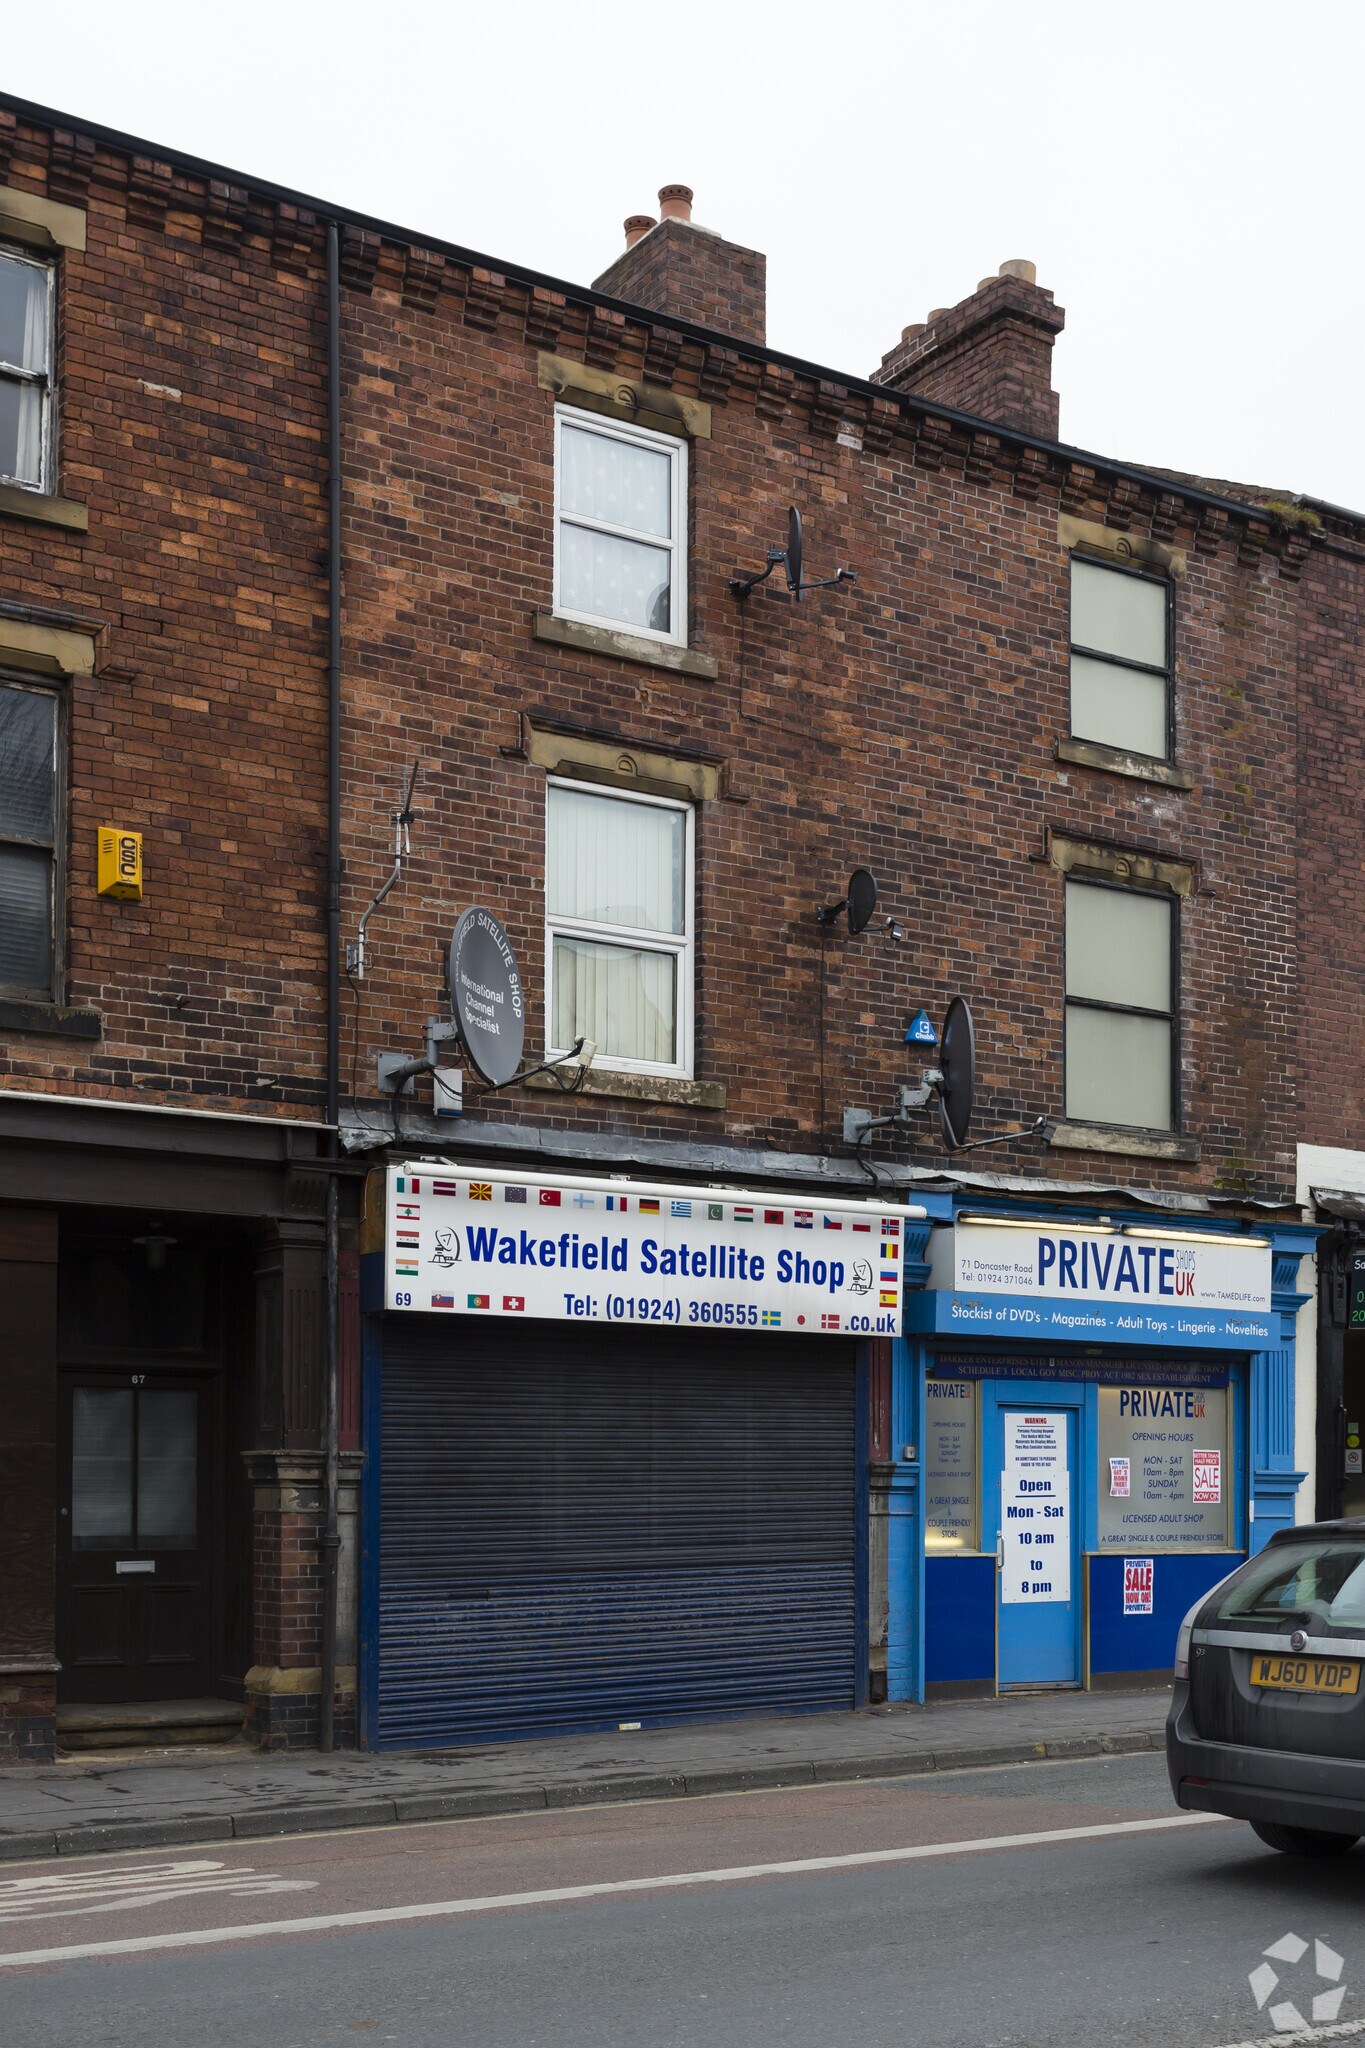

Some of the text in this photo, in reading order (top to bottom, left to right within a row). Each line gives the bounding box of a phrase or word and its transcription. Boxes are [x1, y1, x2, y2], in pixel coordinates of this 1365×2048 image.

[477, 912, 514, 968] SATELLITE
[509, 973, 522, 1018] SHOP
[461, 969, 504, 1004] International
[465, 992, 495, 1017] Channel
[464, 1007, 500, 1035] Specialist
[915, 1032, 935, 1040] Chubb
[466, 1225, 845, 1293] Wakefield Satellite Shop
[961, 1259, 1033, 1273] 71 Doncaster Road
[1038, 1236, 1174, 1295] PRIVATE
[1175, 1249, 1196, 1271] SHOPS
[962, 1272, 1033, 1286] Tel: 01924 371046
[1175, 1271, 1195, 1296] UK
[395, 1292, 412, 1307] 69
[564, 1293, 758, 1326] Tel: (01924) 360555
[844, 1313, 896, 1333] .co.uk
[951, 1304, 1269, 1337] Stockist of DVD's Magazines Adult Toys Lingerie Novelties
[131, 1374, 145, 1384] 67
[958, 1366, 1001, 1375] SCHEDULE
[1011, 1368, 1038, 1376] LOCAL
[1039, 1368, 1056, 1376] GOV
[1104, 1371, 1118, 1379] ACT
[1121, 1371, 1136, 1380] 1982
[1137, 1372, 1151, 1380] SEX
[1153, 1373, 1211, 1382] ESTABLISHMENT
[927, 1383, 965, 1398] PRIVATE
[1119, 1389, 1194, 1418] PRIVATE
[1193, 1404, 1206, 1418] UK
[1132, 1432, 1194, 1442] OPENING HOURS
[1143, 1456, 1183, 1465] MON SAT
[1143, 1468, 1184, 1477] 10am 8pm
[1194, 1467, 1219, 1488] SALE
[1019, 1479, 1051, 1493] Open
[1148, 1479, 1179, 1488] SUNDAY
[934, 1496, 951, 1505] GREAT
[951, 1496, 970, 1505] SINGLE
[1143, 1491, 1184, 1501] 10am 4pm
[1194, 1492, 1219, 1500] NOW ON
[1007, 1505, 1064, 1518] Mon Sat
[1122, 1514, 1204, 1523] LICENSED ADULT SHOP
[927, 1518, 971, 1528] COUPLE FRIENDLY
[941, 1530, 958, 1538] STORE
[1018, 1532, 1054, 1544] 10 am
[1107, 1534, 1127, 1542] GREAT
[1128, 1534, 1148, 1542] SINGLE
[1150, 1534, 1155, 1542] &
[1156, 1534, 1179, 1542] COUPLE
[1180, 1534, 1205, 1542] FRIENDLY
[1030, 1559, 1043, 1571] to
[1126, 1560, 1146, 1568] PRIVATE
[1125, 1567, 1152, 1591] SALE
[1021, 1581, 1052, 1594] 8 pm
[1125, 1592, 1139, 1604] NOW
[1125, 1604, 1146, 1612] PRIVATE
[1259, 1659, 1352, 1688] WJ60 VDP
